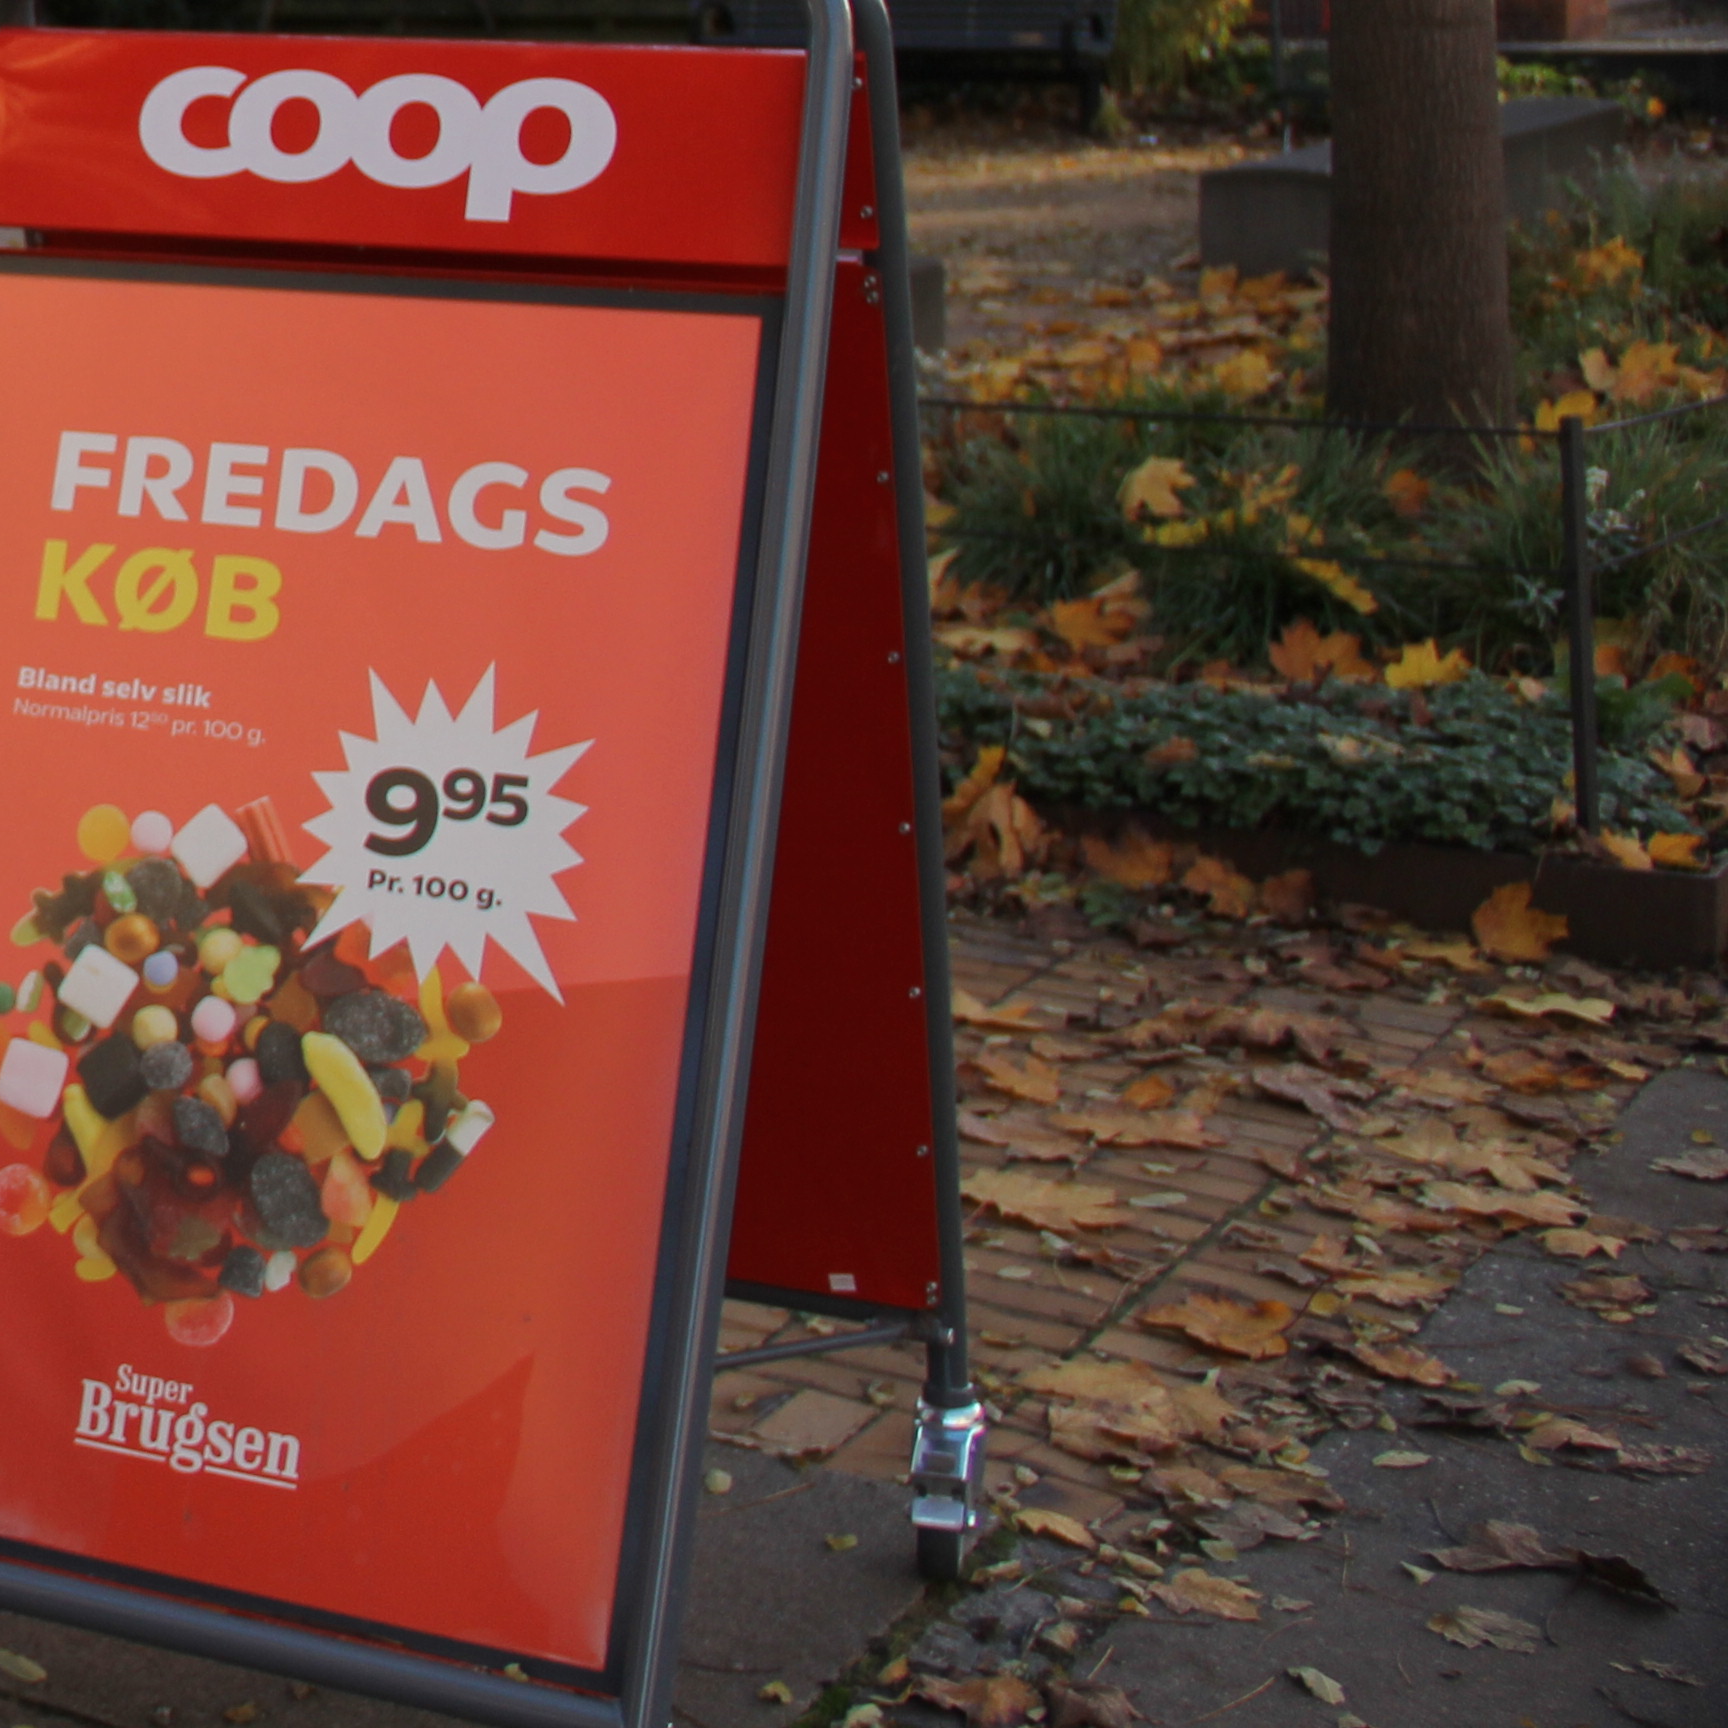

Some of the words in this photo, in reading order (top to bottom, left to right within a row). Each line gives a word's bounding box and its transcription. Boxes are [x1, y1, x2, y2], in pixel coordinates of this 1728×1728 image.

[138, 65, 618, 223] coop
[50, 430, 612, 557] FREDAGS
[35, 538, 284, 642] KØB
[13, 697, 124, 727] Normalpris
[171, 716, 198, 737] pr.
[202, 719, 243, 741] 100
[246, 727, 267, 747] g.
[17, 666, 95, 696] Bland
[101, 675, 158, 702] selv
[162, 684, 213, 709] slik
[367, 869, 404, 895] Pr.
[412, 874, 468, 901] 100
[475, 884, 503, 910] g.
[115, 1363, 193, 1405] Super
[74, 1378, 301, 1485] Brugsen
